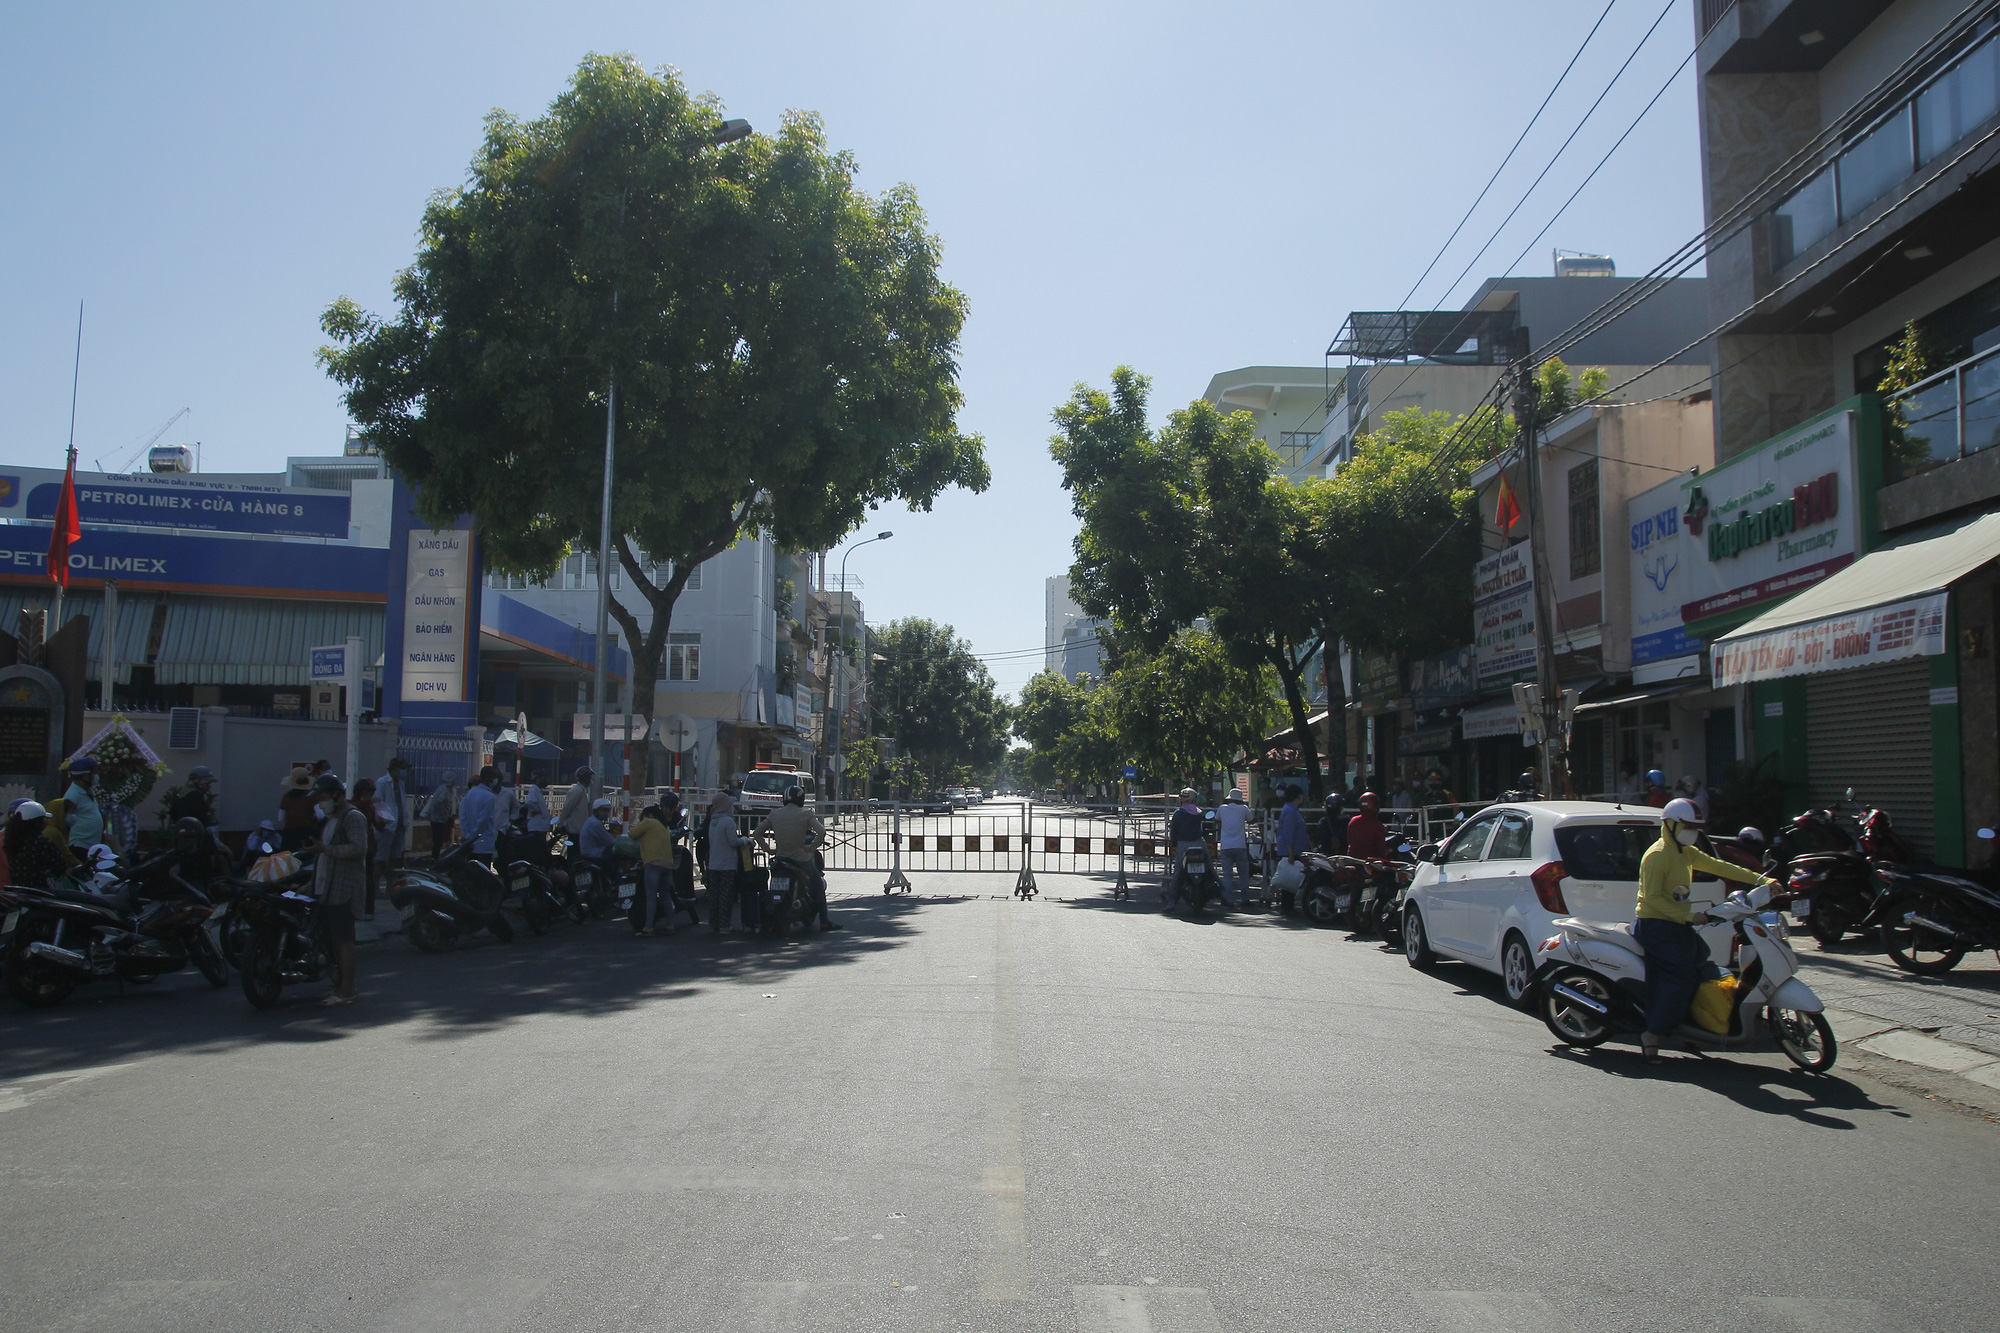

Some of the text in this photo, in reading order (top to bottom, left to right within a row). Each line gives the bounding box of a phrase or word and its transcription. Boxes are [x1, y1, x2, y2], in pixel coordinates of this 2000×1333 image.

[107, 473, 131, 482] CÔNG
[147, 476, 169, 485] XĂNG
[171, 477, 187, 486] DẦU
[209, 482, 225, 490] VỰC
[241, 484, 262, 492] TNHH
[240, 499, 289, 516] HÀNG
[293, 505, 304, 517] 8
[1631, 518, 1653, 555] SỊP
[418, 539, 459, 549] XĂNG DẦU
[1778, 528, 1838, 562] Pharmacy
[0, 549, 167, 574] PETOLIMEX
[428, 568, 445, 577] GAS
[415, 593, 432, 606] DẦU
[1501, 609, 1522, 624] PHONG
[415, 620, 453, 634] BẢO HIỂM
[1791, 627, 1815, 642] Chuyên
[1816, 623, 1831, 637] Kinh
[409, 651, 456, 663] NGÂN HÀNG
[1775, 646, 1796, 672] GẠO
[1804, 639, 1825, 669] BỘT
[1833, 628, 1871, 661] ĐƯỜNG
[314, 663, 343, 674] ĐỐNG ĐA
[416, 681, 447, 693] DỊCH VỤ
[748, 794, 784, 802] AMBULANC
